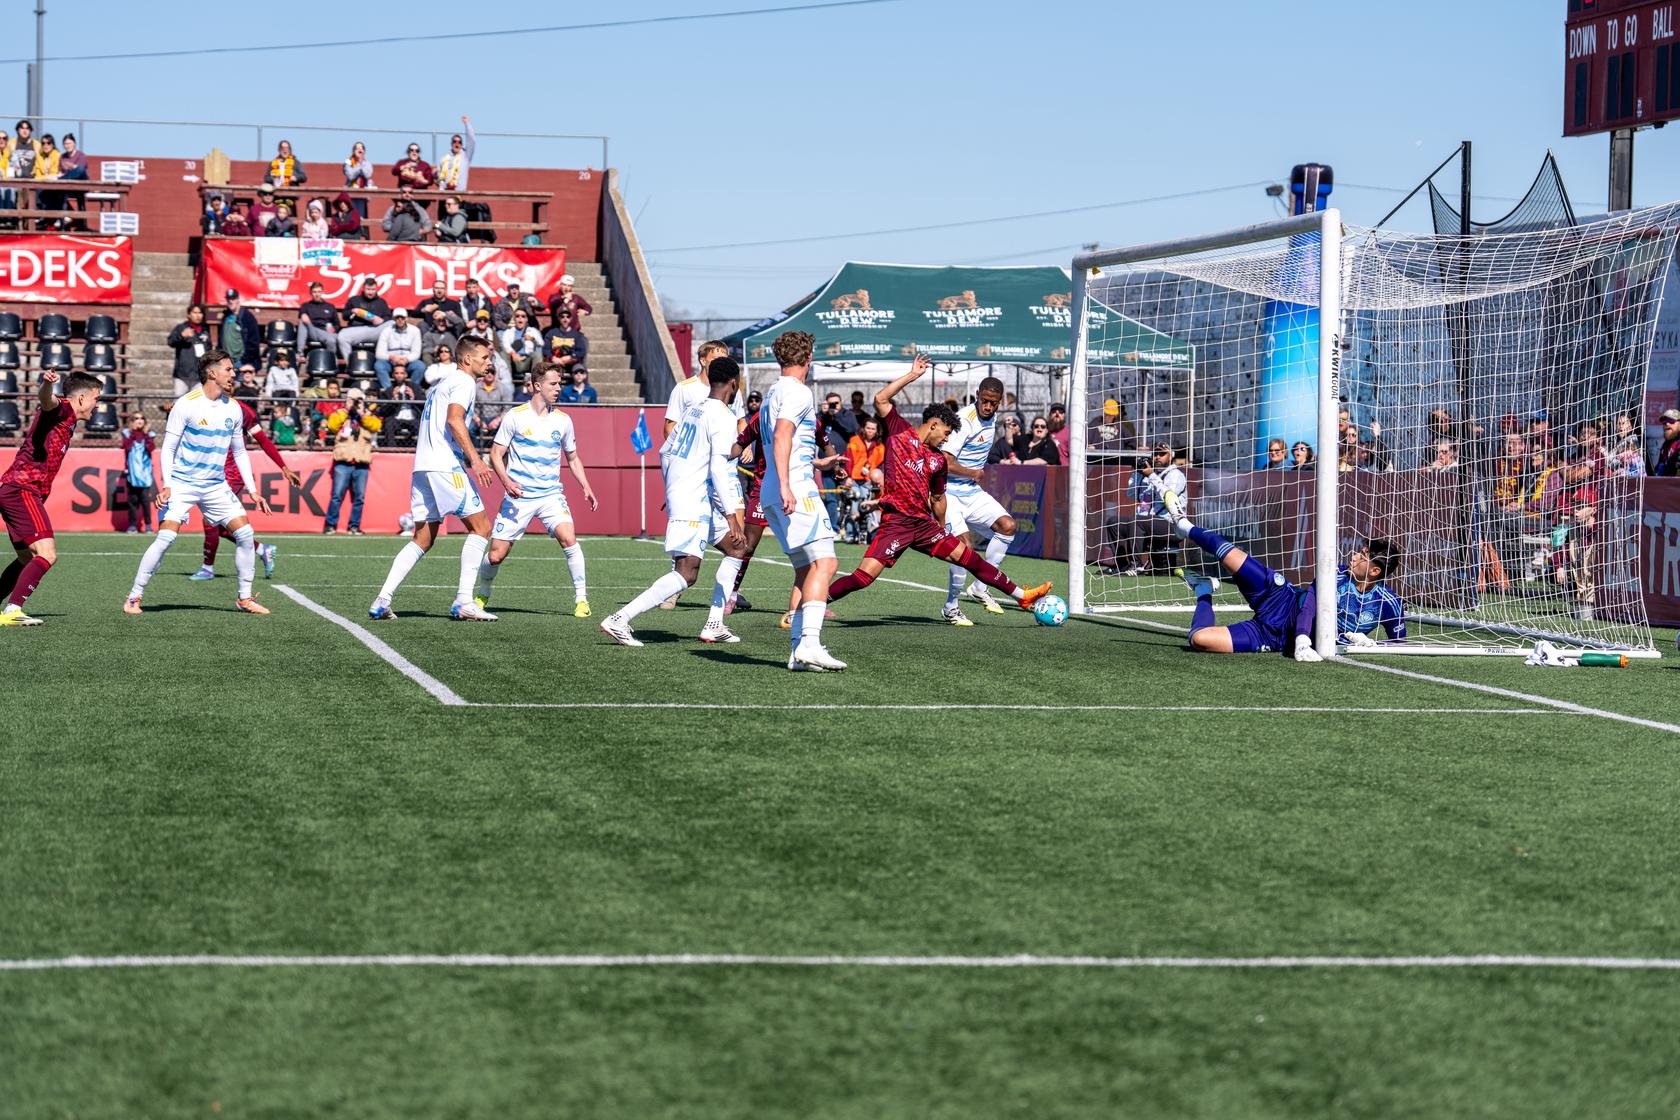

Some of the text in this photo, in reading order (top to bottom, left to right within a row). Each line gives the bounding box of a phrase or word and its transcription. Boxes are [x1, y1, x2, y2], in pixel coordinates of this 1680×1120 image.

[1569, 6, 1674, 59] DOWN TO GO BALL
[578, 171, 591, 180] 20
[815, 309, 896, 320] TULLAMORE
[922, 306, 1002, 318] TULLAMORE
[916, 344, 950, 352] TULLAMORE
